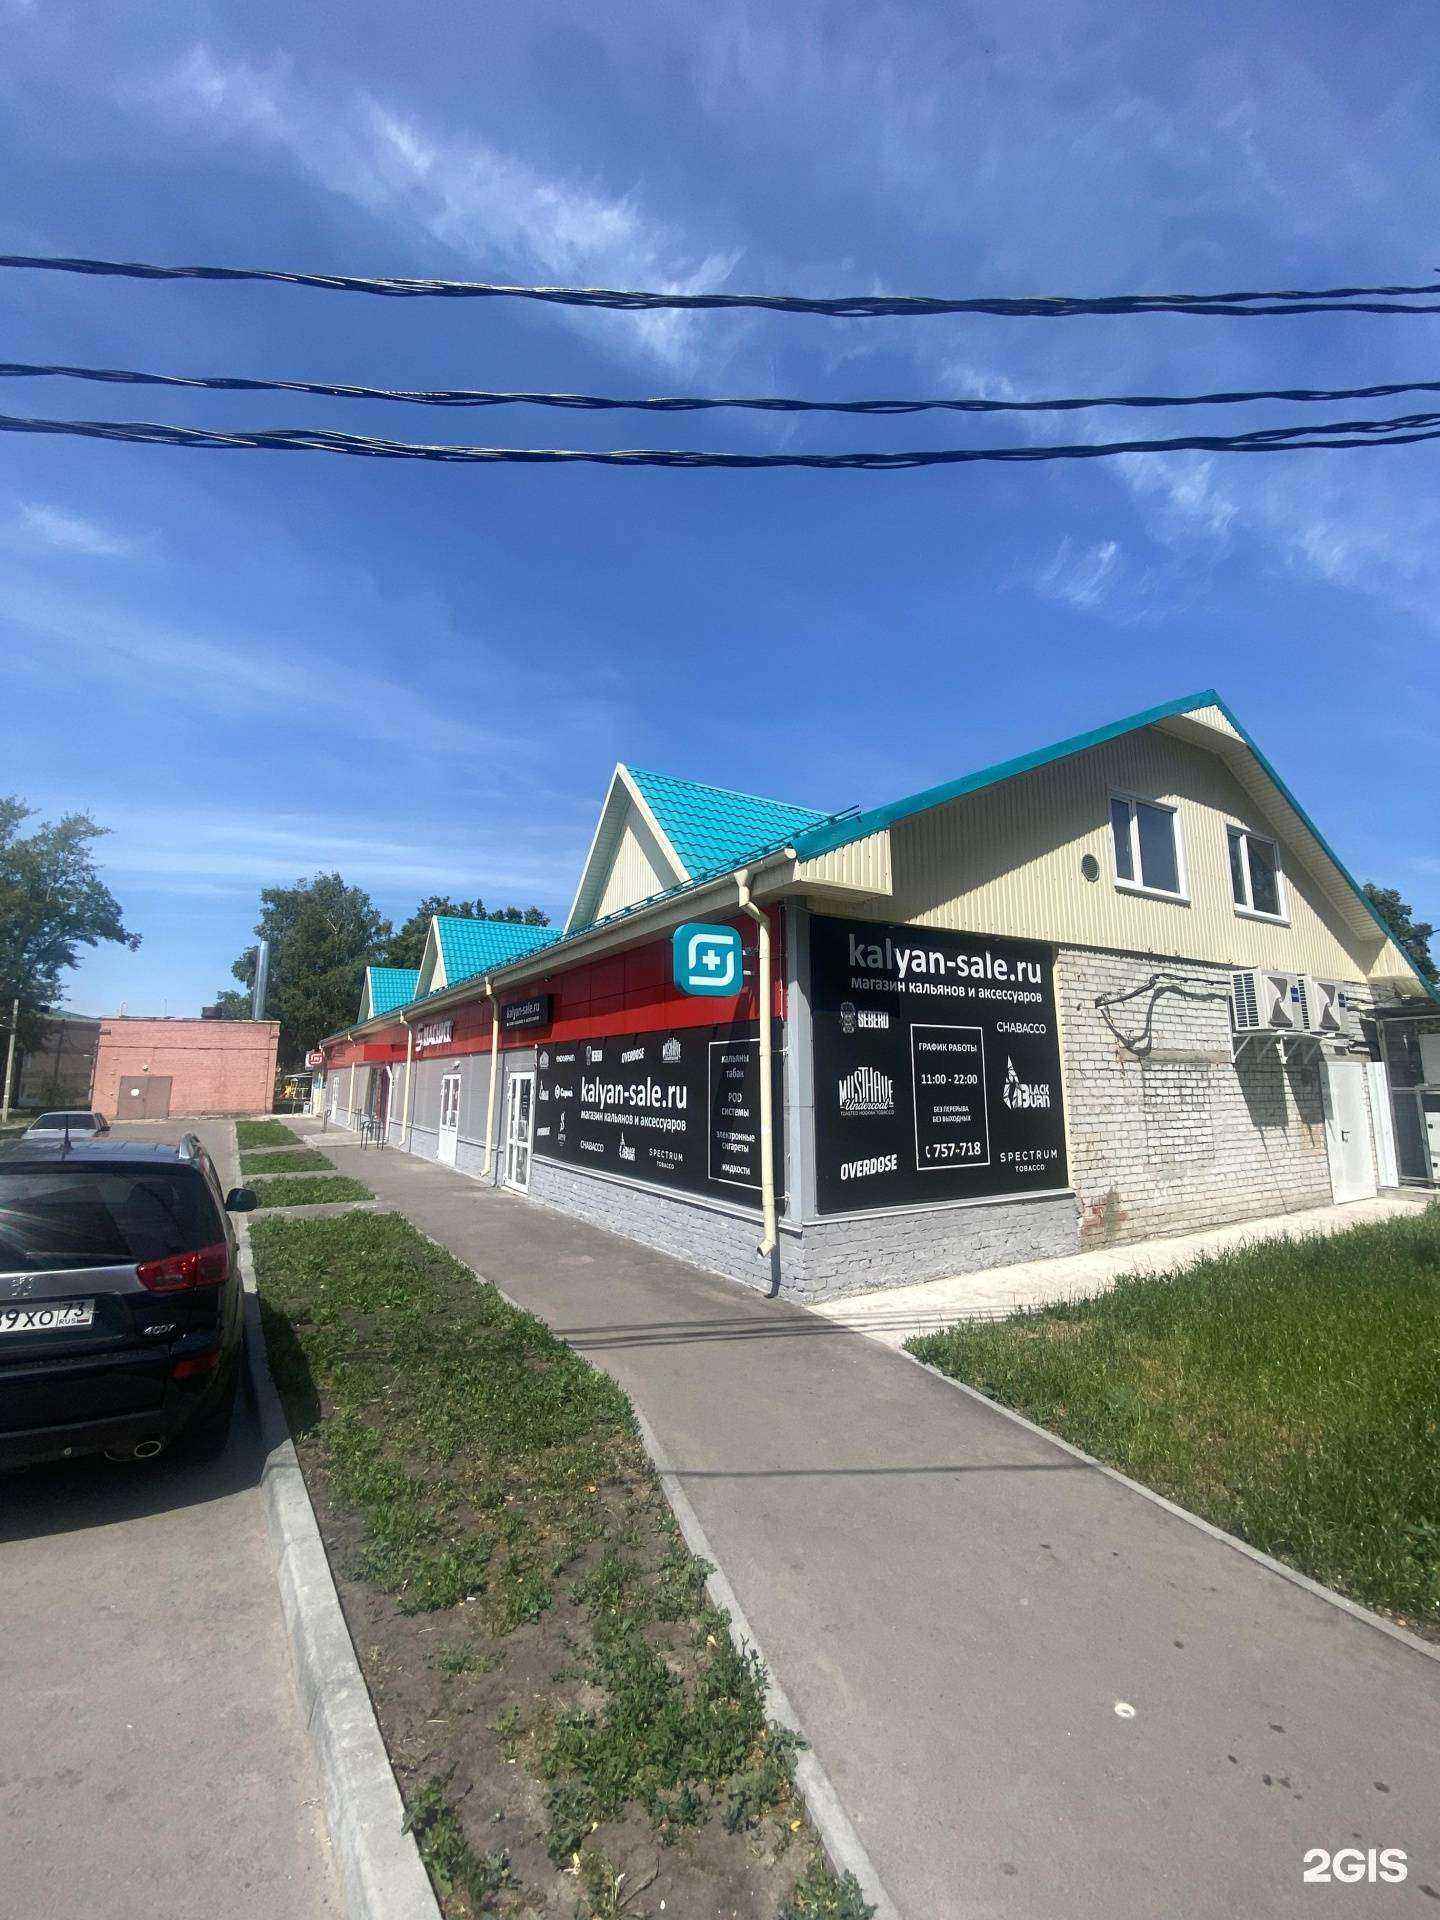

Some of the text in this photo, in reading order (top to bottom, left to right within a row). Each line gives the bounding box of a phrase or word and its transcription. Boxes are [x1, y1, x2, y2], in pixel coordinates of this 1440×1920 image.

[848, 933, 1042, 984] kalyan-sale.ru
[850, 977, 1042, 1004] магазин кальянов и аксессуаров
[996, 1021, 1047, 1034] CHABACCO
[918, 1042, 977, 1052] ГРАФИК РАБОТЫ
[839, 1066, 893, 1106] MUSTHAVE
[921, 1074, 947, 1085] 11:00
[953, 1074, 978, 1085] 22:00
[580, 1076, 687, 1110] kalyan-sale.ru
[640, 1116, 687, 1133] аксессуаров
[649, 1147, 684, 1162] SPECTRUM
[1000, 1149, 1058, 1163] SPECTRUM
[840, 1154, 898, 1181] OVERDOSE
[1015, 1164, 1045, 1173] TOBACCO
[59, 1318, 77, 1326] RUS
